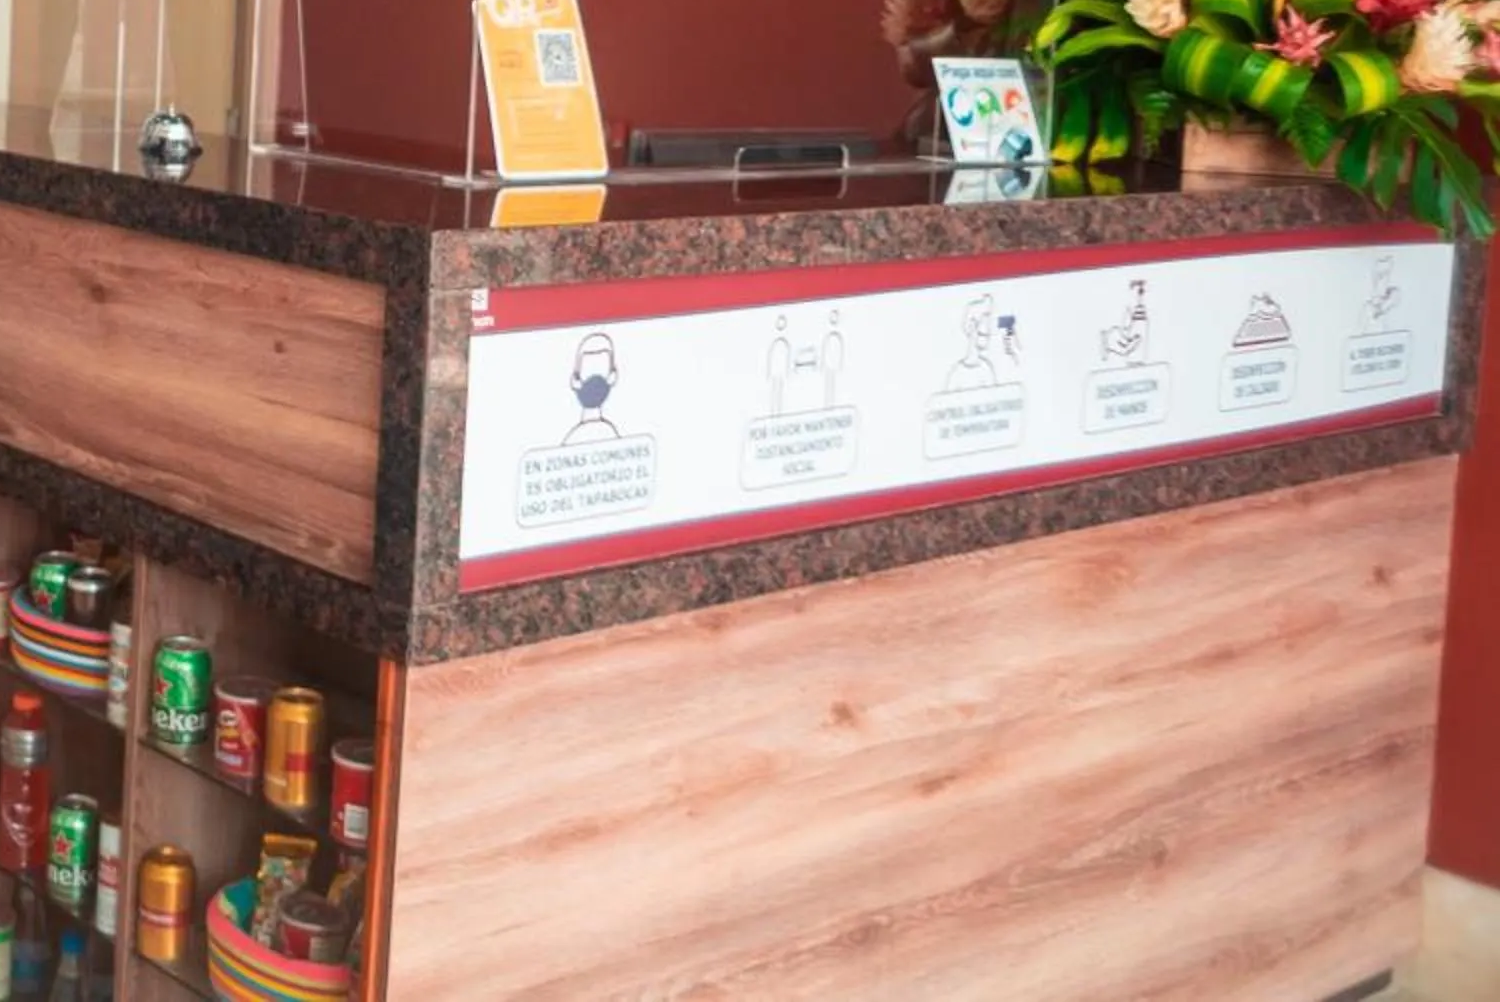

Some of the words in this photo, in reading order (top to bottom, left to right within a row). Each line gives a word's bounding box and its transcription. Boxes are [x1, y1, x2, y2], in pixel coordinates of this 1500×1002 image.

[525, 460, 541, 475] EN
[546, 455, 587, 472] ZONAS
[591, 445, 650, 466] COMUNES
[526, 481, 541, 496] ES
[545, 467, 633, 493] OBLIGATORIO
[636, 464, 649, 479] EL
[521, 500, 547, 517] USO
[550, 496, 573, 513] DEL
[579, 486, 648, 508] TAPABOCAS
